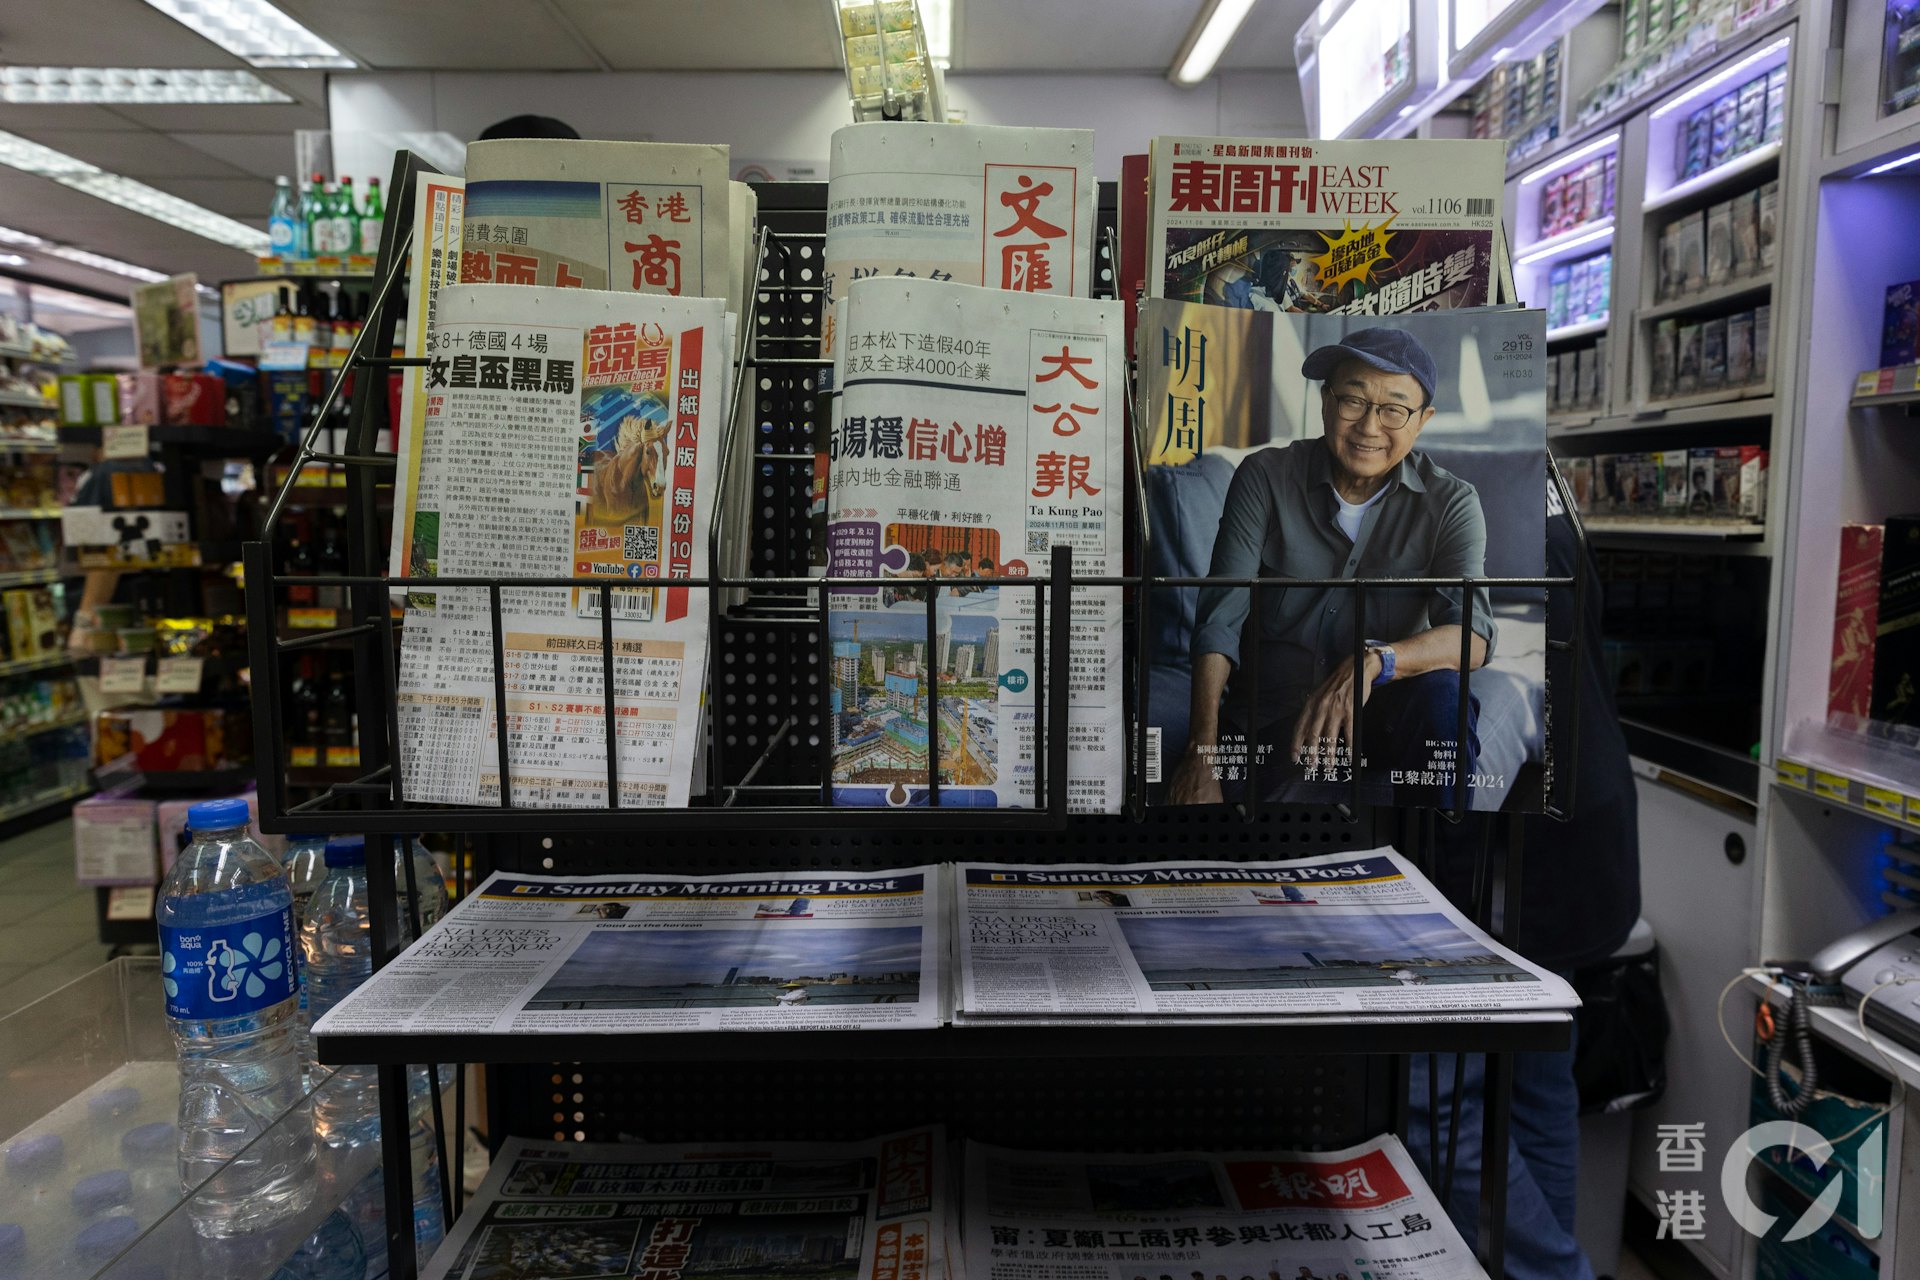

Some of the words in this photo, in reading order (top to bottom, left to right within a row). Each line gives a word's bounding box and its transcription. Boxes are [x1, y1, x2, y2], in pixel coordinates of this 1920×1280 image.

[1213, 144, 1312, 162] 星島新聞集團刊物
[1321, 165, 1390, 189] EAST
[1168, 160, 1318, 213] 東周刊
[617, 190, 692, 225] 香港
[1320, 192, 1400, 214] WEEK
[890, 210, 971, 228] 確保流動性合理充裕
[623, 234, 683, 298] 商
[588, 322, 671, 378] 競馬
[848, 330, 992, 358] 日本松下造假40年
[1502, 341, 1533, 352] 2919
[429, 354, 575, 395] 女皇盃黑馬
[847, 356, 993, 383] 波及全球4000企業
[1503, 370, 1533, 378] HKD30
[1160, 325, 1208, 461] 明周
[675, 368, 701, 468] 出紙八版
[1031, 345, 1102, 500] 大公報
[896, 507, 992, 525] 平穩化債，利好誰？
[1029, 506, 1044, 516] Ta
[1048, 506, 1079, 518] Kung
[1083, 507, 1104, 516] Pao
[1082, 521, 1101, 529] 星期日
[593, 563, 625, 576] YouTube
[1008, 565, 1026, 576] 股市
[1007, 676, 1025, 685] 樓市
[1211, 766, 1249, 782] 蒙嘉
[1466, 774, 1505, 789] 2024
[1026, 872, 1149, 884] Sunday
[1153, 868, 1298, 883] Morning
[1298, 862, 1373, 879] Post
[550, 881, 677, 897] Sunday
[680, 880, 823, 896] Morning
[827, 878, 899, 893] Post
[282, 911, 291, 931] ME
[970, 916, 1006, 924] XIA
[1010, 916, 1077, 924] URGES
[971, 922, 1065, 931] TYCOONS
[1071, 922, 1097, 931] TO
[179, 934, 195, 943] bon
[432, 935, 532, 944] TYCOONS
[535, 935, 562, 944] TO
[437, 927, 476, 936] XIA
[480, 927, 550, 936] URGES
[971, 929, 1027, 937] BACK
[1029, 929, 1098, 939] MAJOR
[180, 942, 202, 950] aqua
[422, 942, 481, 951] BACK
[482, 942, 554, 953] MAJOR
[971, 936, 1072, 945] PROJECTS
[412, 950, 515, 960] PROJECTS
[284, 934, 296, 994] RECYCLE
